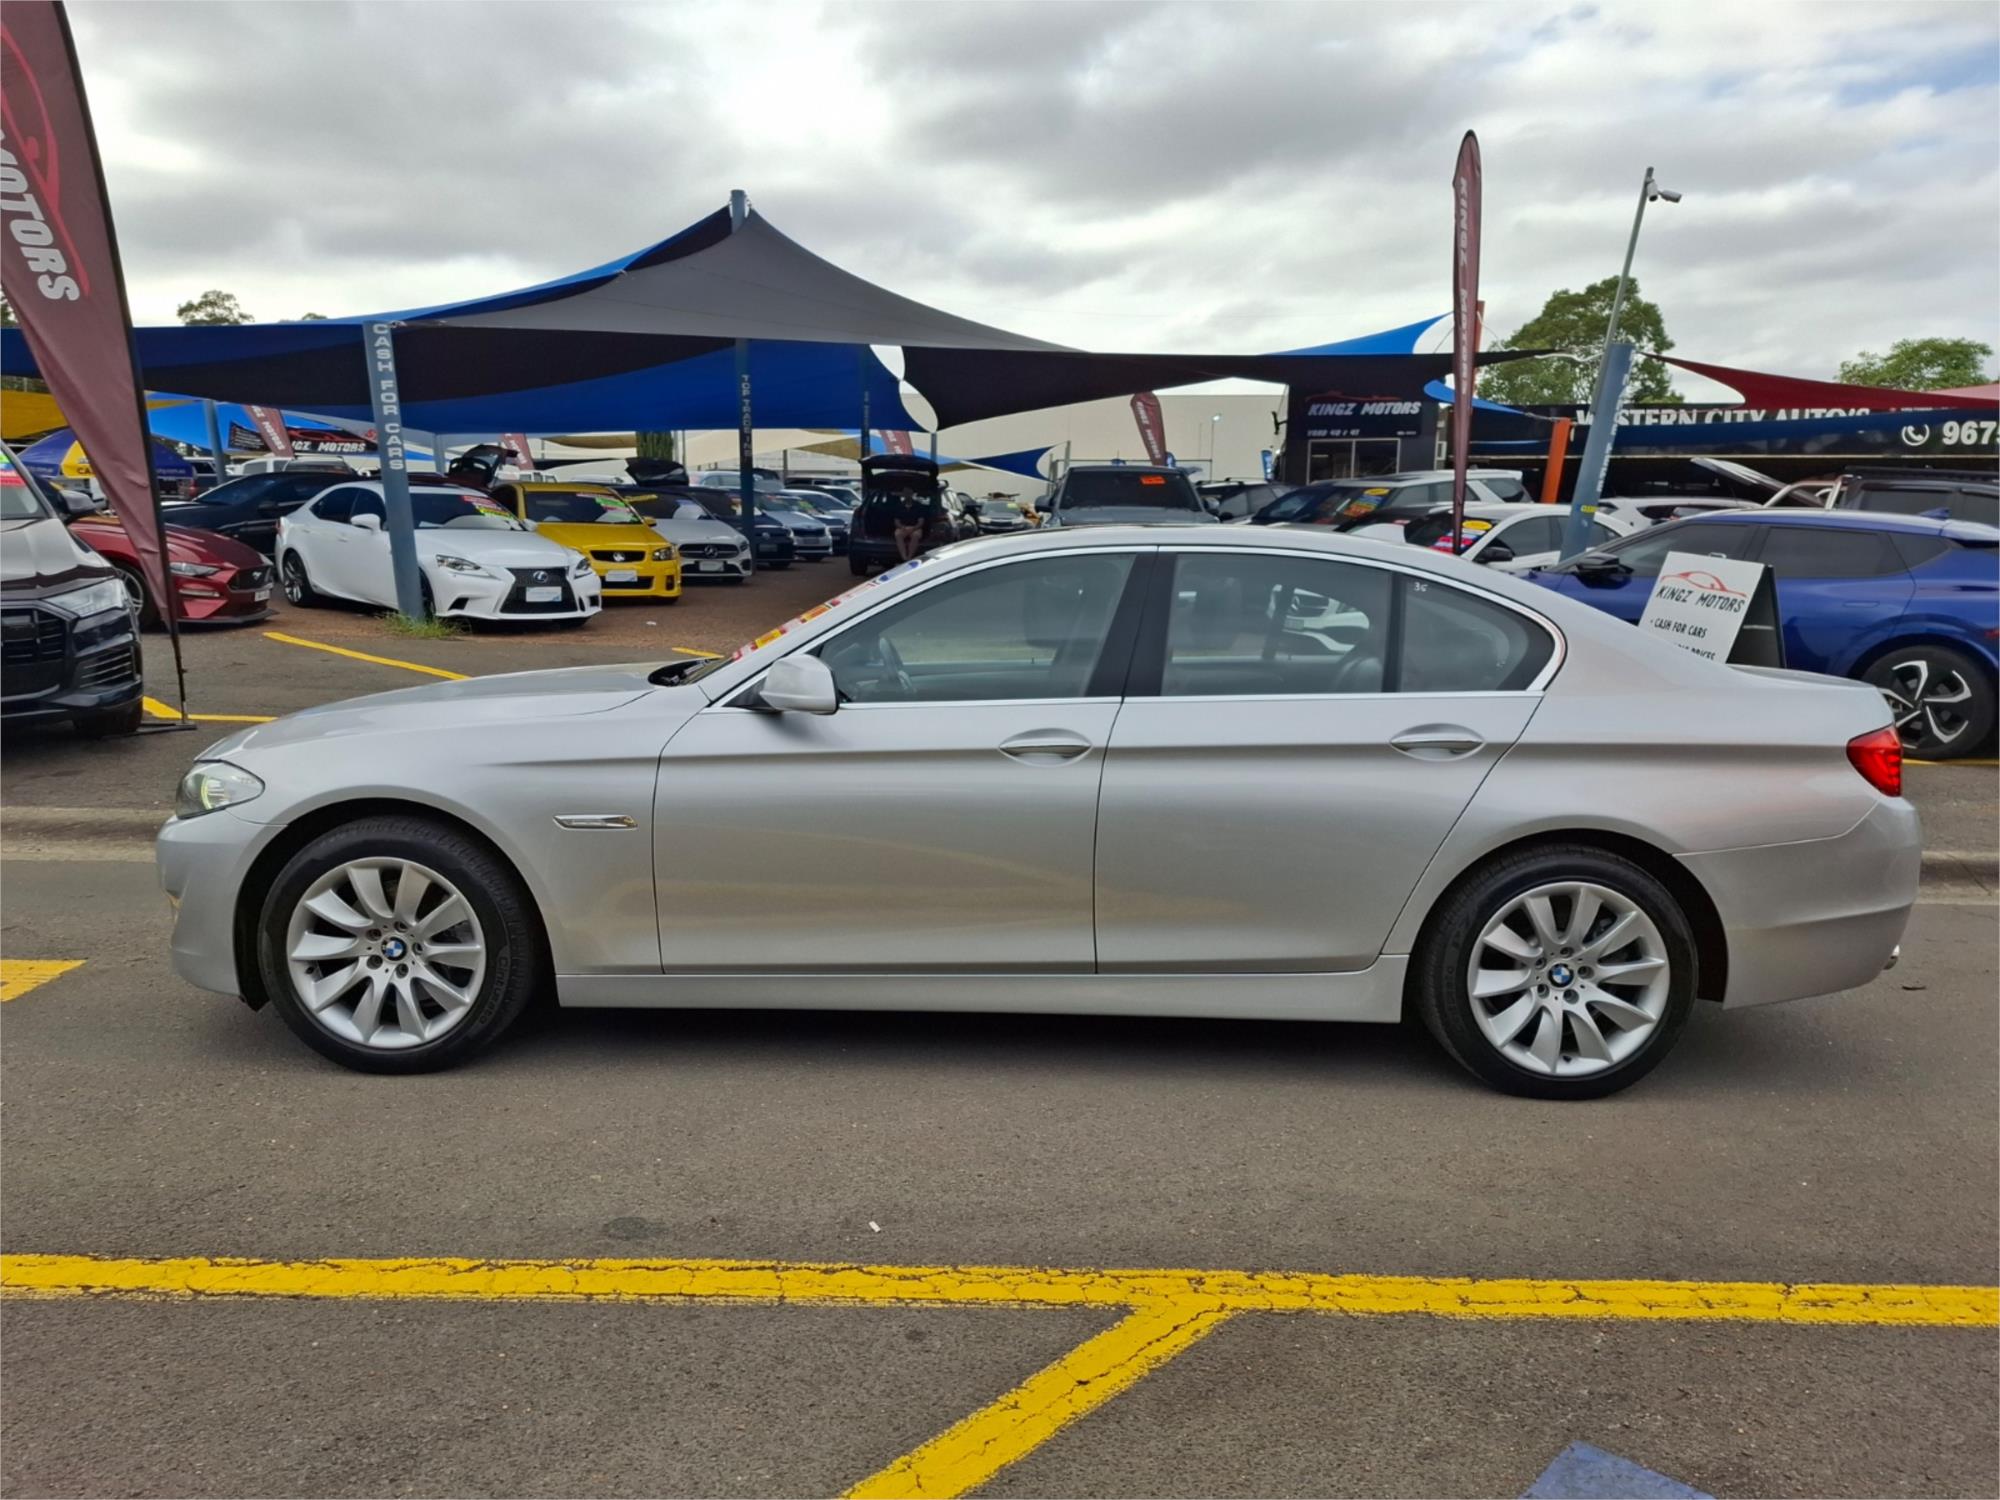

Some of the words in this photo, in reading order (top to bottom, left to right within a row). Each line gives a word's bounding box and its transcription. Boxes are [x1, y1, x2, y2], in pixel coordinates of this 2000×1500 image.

[372, 323, 394, 372] CASH
[741, 374, 751, 397] TOP
[380, 380, 398, 416] FOR
[1307, 403, 1356, 416] KINGZ
[1360, 402, 1421, 415] MOTORS
[1576, 409, 1697, 426] WSTERN
[1704, 409, 1766, 424] CITY
[1942, 420, 1999, 445] 967
[318, 441, 366, 452] MOTORS
[384, 423, 405, 470] CARS
[1656, 585, 1694, 604] KINGZ
[1694, 592, 1746, 613] MOTORS
[1653, 618, 1672, 630] CASH
[1671, 620, 1687, 633] FOR
[1687, 624, 1708, 639] CARS
